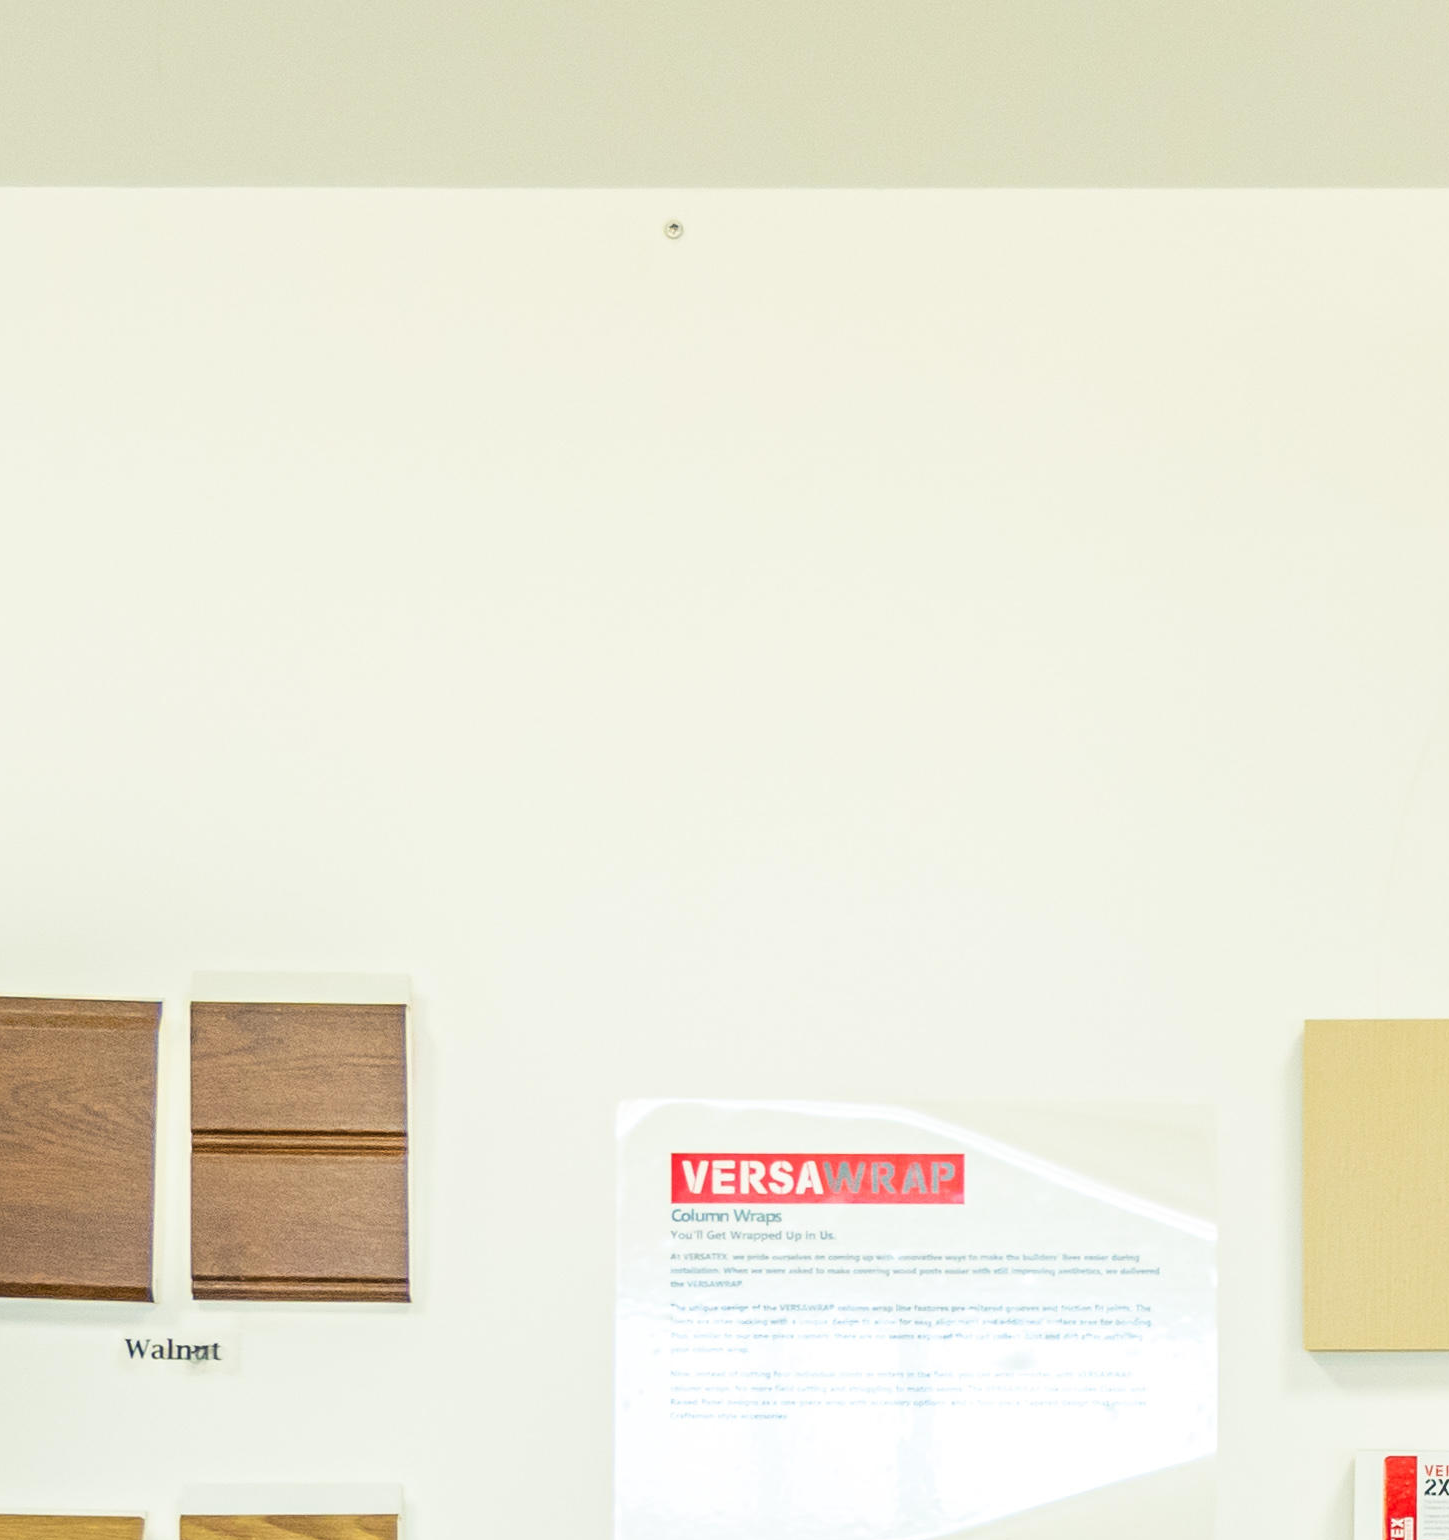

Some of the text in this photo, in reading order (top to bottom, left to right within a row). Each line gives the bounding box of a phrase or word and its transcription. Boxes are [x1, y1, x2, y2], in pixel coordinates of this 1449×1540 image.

[682, 1159, 956, 1195] VERSAWRAP
[671, 1209, 782, 1225] Column Wraps
[670, 1230, 836, 1242] You'll Get Wrapped Up in Us.
[125, 1339, 221, 1360] Walnut
